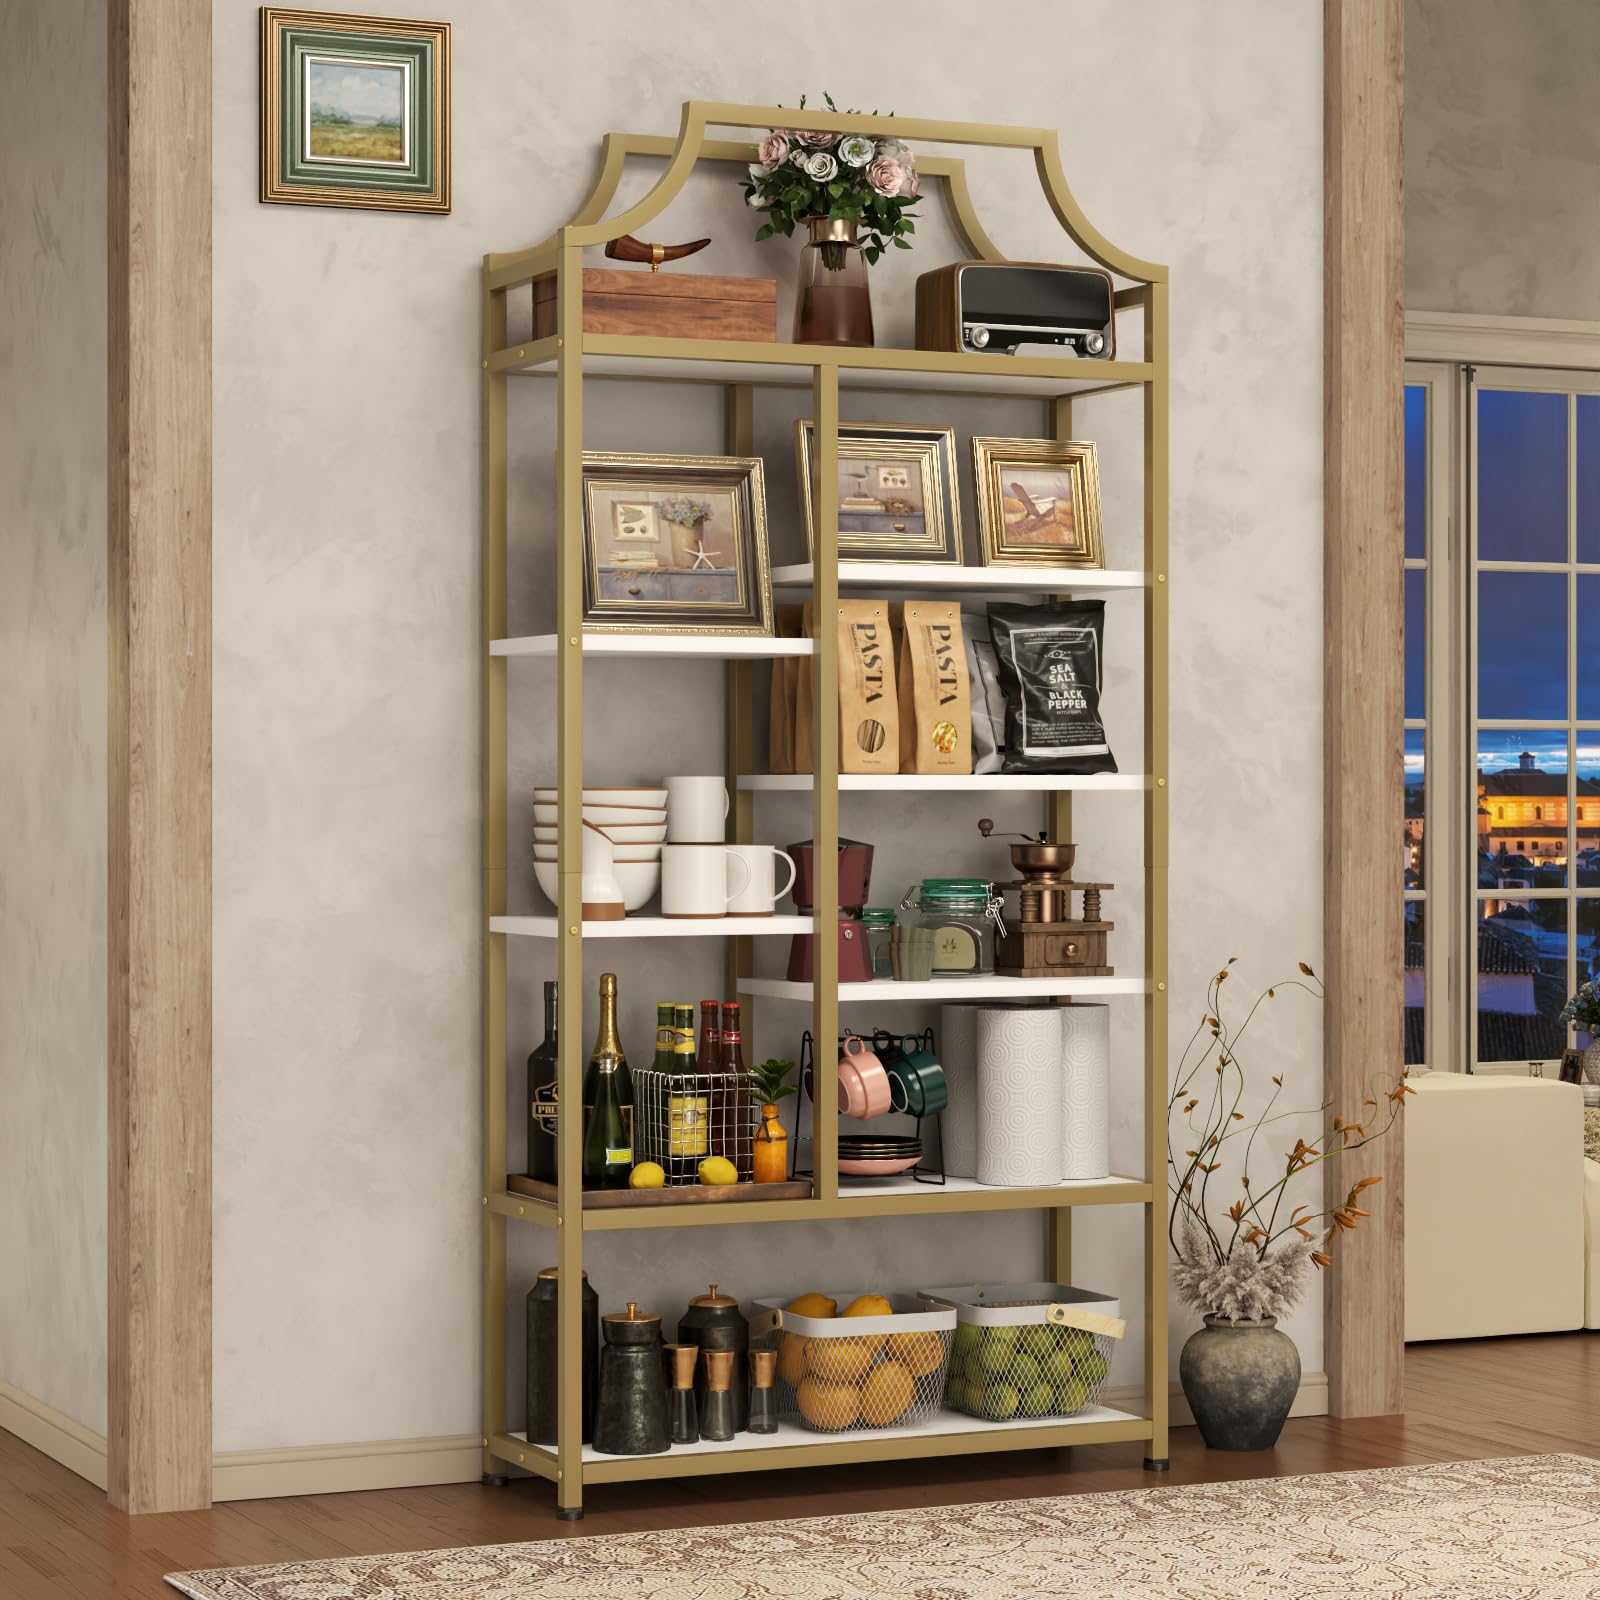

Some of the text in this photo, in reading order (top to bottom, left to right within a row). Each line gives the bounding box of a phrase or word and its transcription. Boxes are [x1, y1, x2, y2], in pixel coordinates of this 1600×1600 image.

[856, 623, 883, 704] PASTA
[932, 625, 958, 706] PASTA
[1049, 663, 1072, 674] SEA
[1048, 672, 1076, 684] SALT
[1049, 690, 1084, 700] BLACK
[1048, 699, 1088, 710] PEPPER
[537, 1105, 559, 1114] PRE
